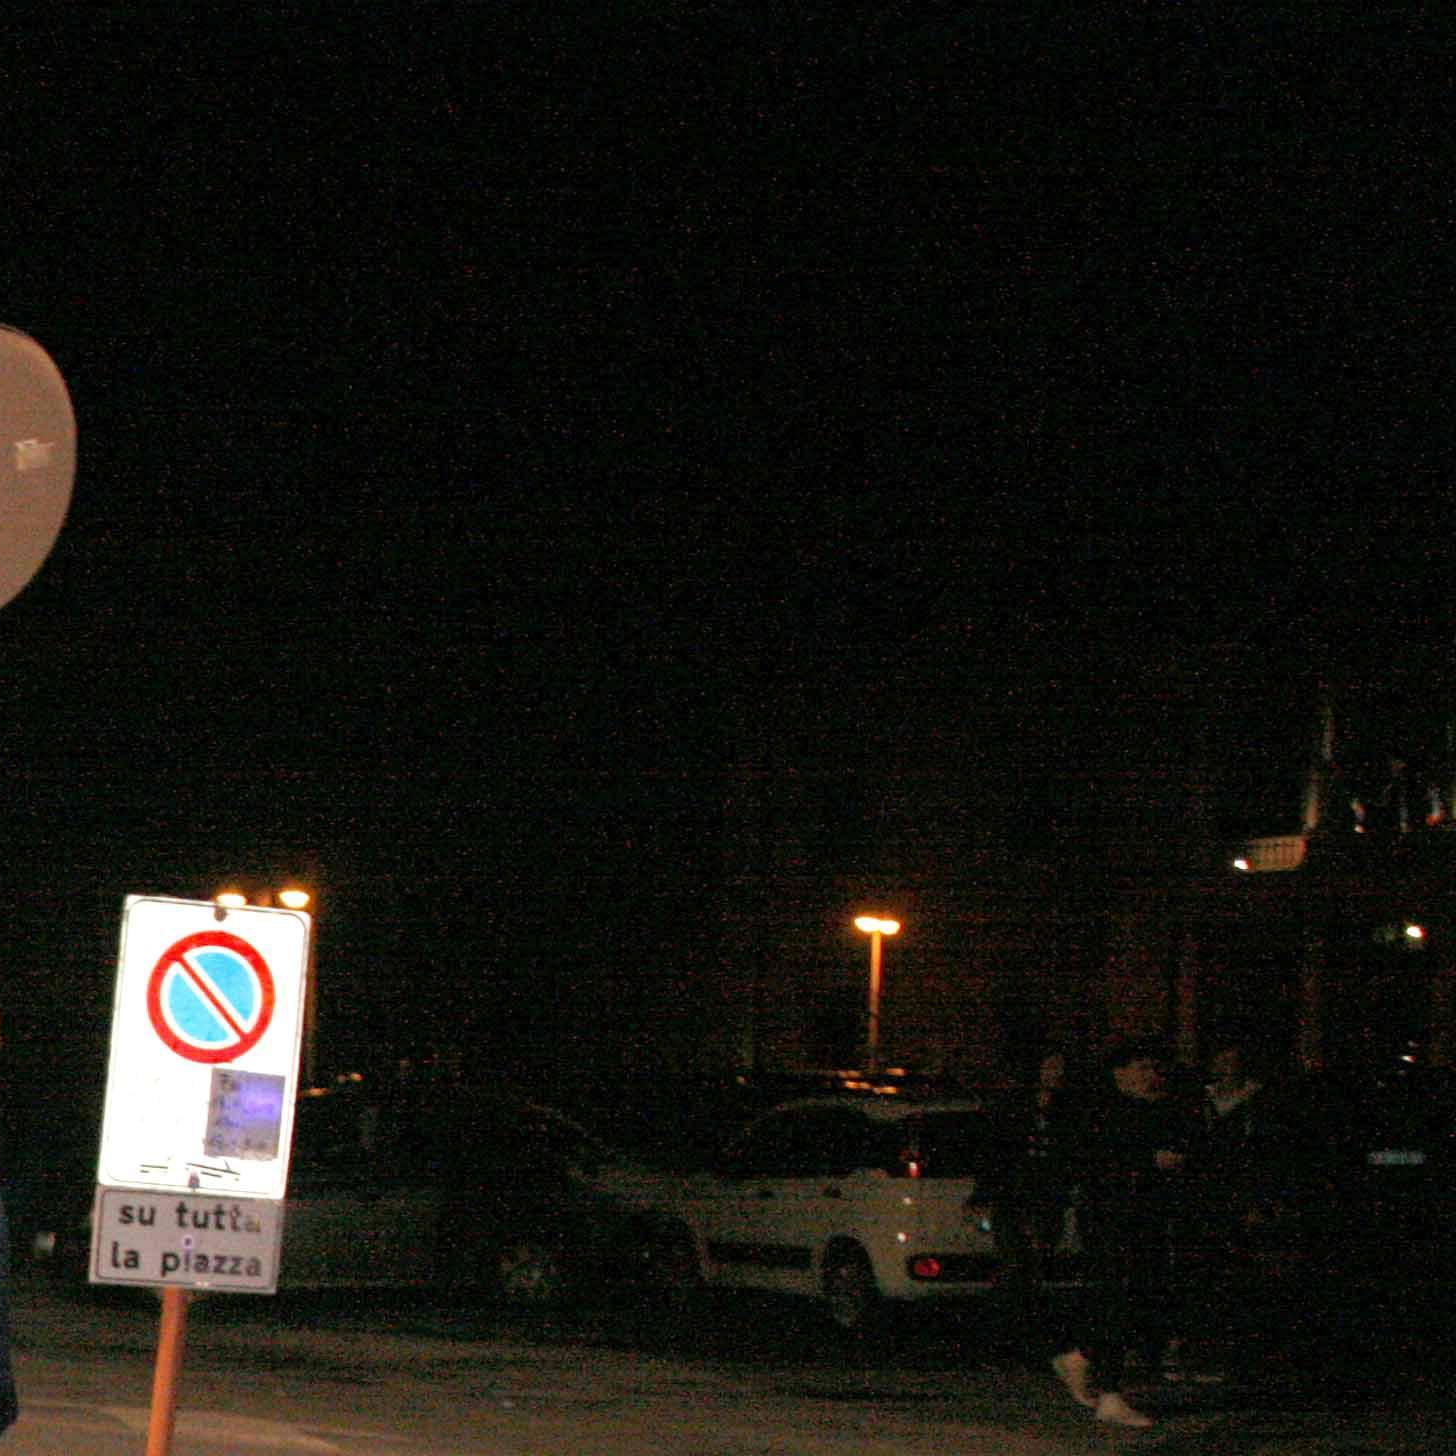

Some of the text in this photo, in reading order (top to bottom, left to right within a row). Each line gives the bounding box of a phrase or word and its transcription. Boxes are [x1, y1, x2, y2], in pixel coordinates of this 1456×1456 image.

[118, 1201, 262, 1233] su tutta
[111, 1237, 262, 1277] la piazza
